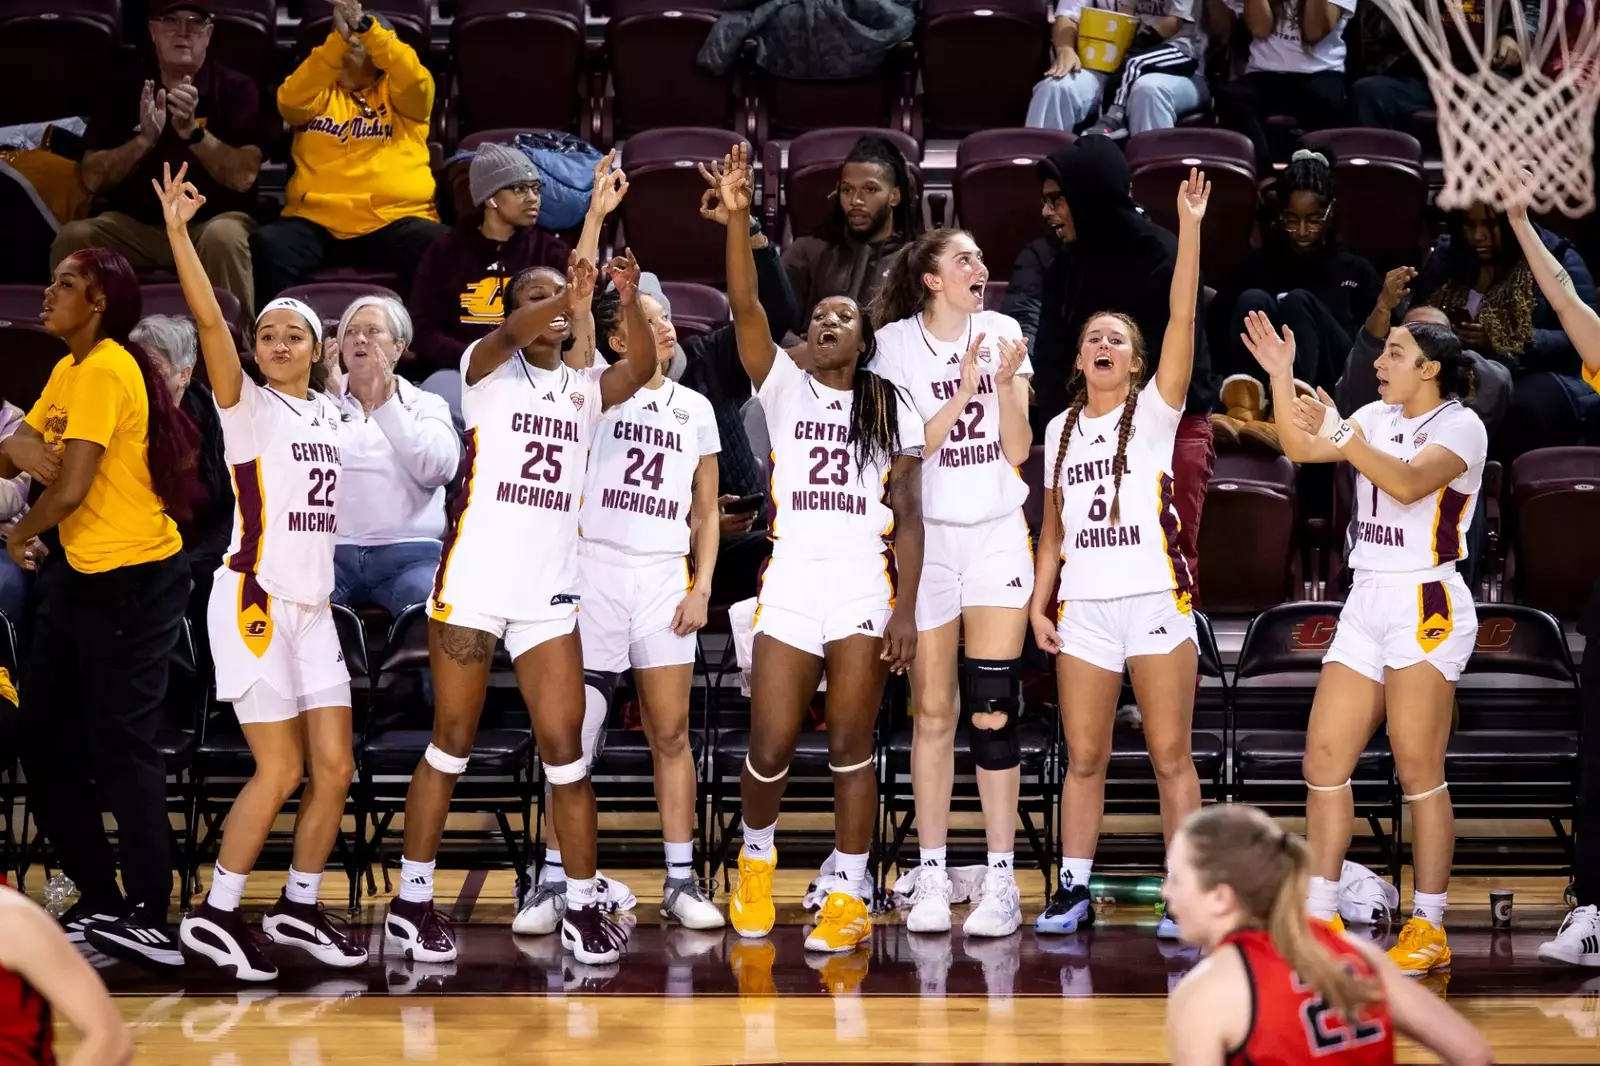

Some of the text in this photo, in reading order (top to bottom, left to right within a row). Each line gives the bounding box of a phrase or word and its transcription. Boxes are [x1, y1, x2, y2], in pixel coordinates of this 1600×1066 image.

[511, 412, 579, 442] CENTRAL
[614, 420, 683, 453] CENTRAL
[794, 421, 850, 443] CENTR
[520, 441, 563, 484] 25
[623, 447, 665, 491] 24
[808, 446, 850, 486] 23
[939, 441, 1001, 468] MCHIGAN
[308, 468, 337, 507] 22
[496, 481, 572, 512] MICHIGAN
[792, 490, 867, 516] MICHIGAN
[1088, 484, 1107, 522] 6
[601, 488, 679, 520] MICHIGAN
[1075, 525, 1141, 549] ICHIGAN
[1357, 521, 1404, 547] CHIGAN
